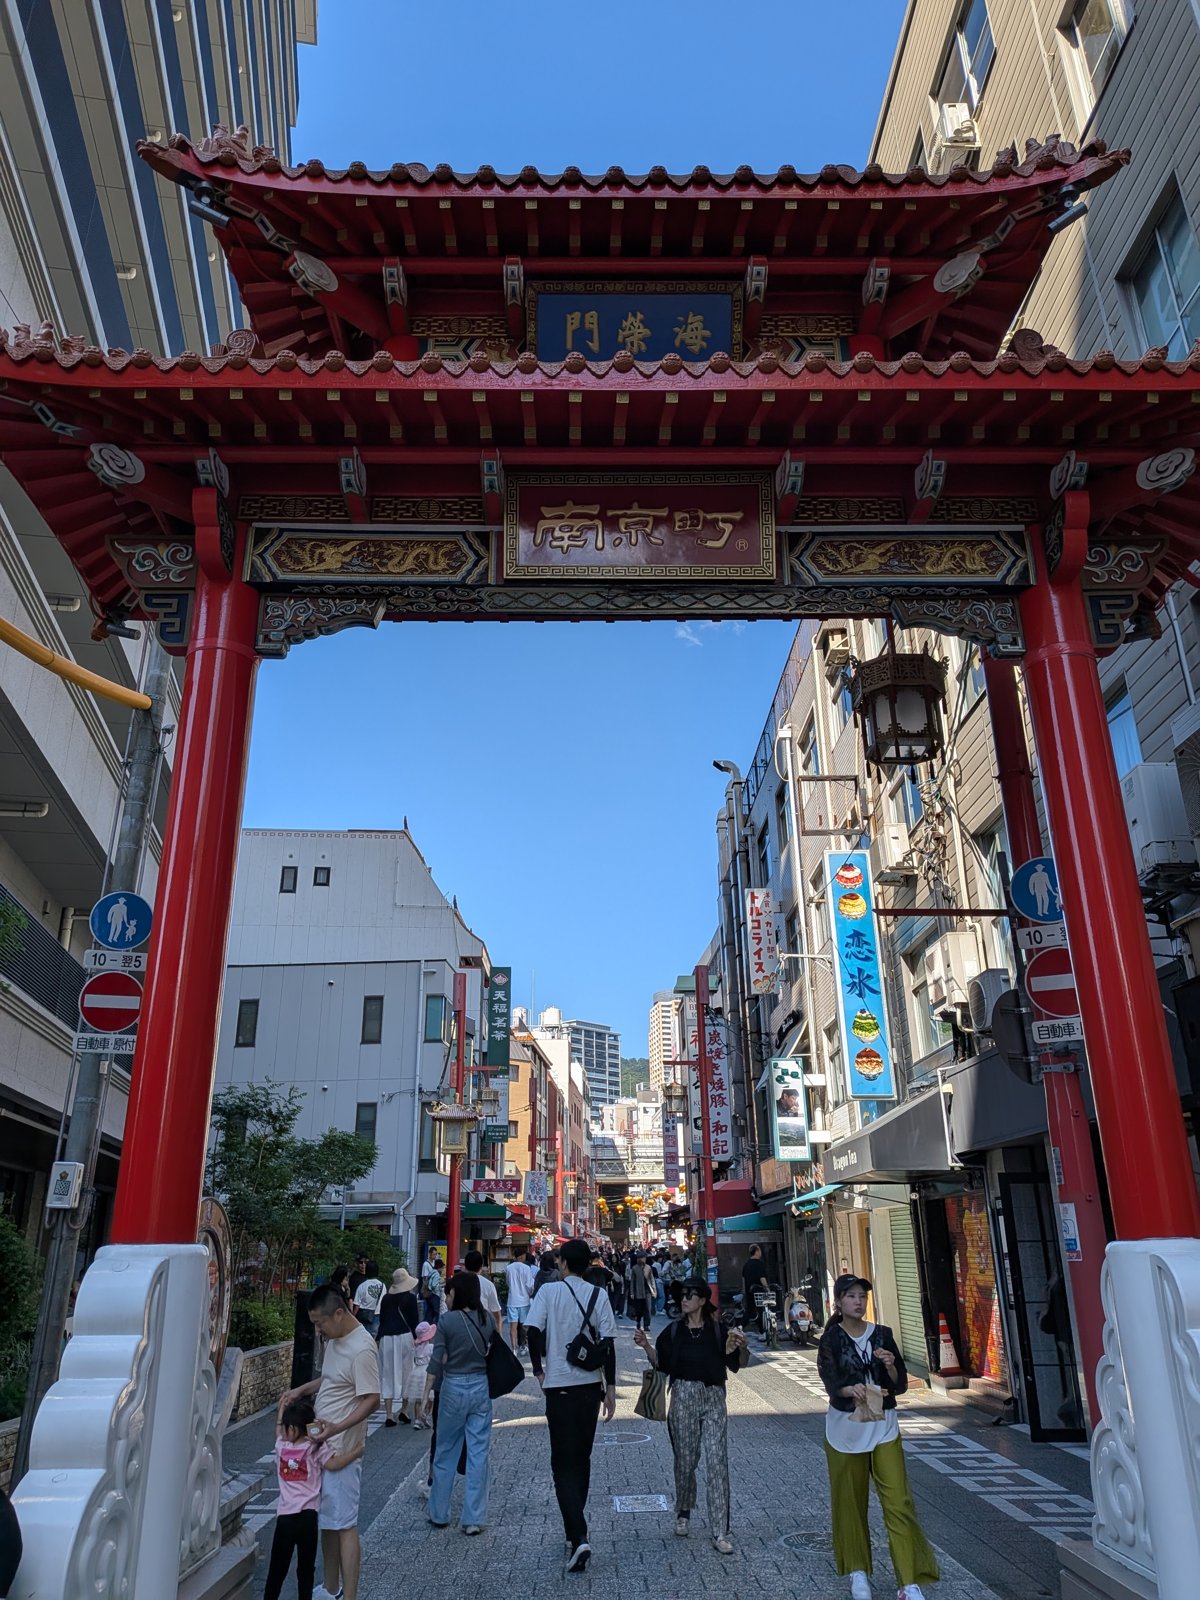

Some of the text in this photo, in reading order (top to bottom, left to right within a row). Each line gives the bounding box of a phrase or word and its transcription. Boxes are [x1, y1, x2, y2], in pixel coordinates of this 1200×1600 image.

[533, 500, 744, 554] 南京町
[749, 891, 765, 973] トルコライス
[845, 928, 881, 998] 恋氷
[491, 990, 508, 1041] 天福茗茶
[833, 1149, 858, 1170] Dragon Tea
